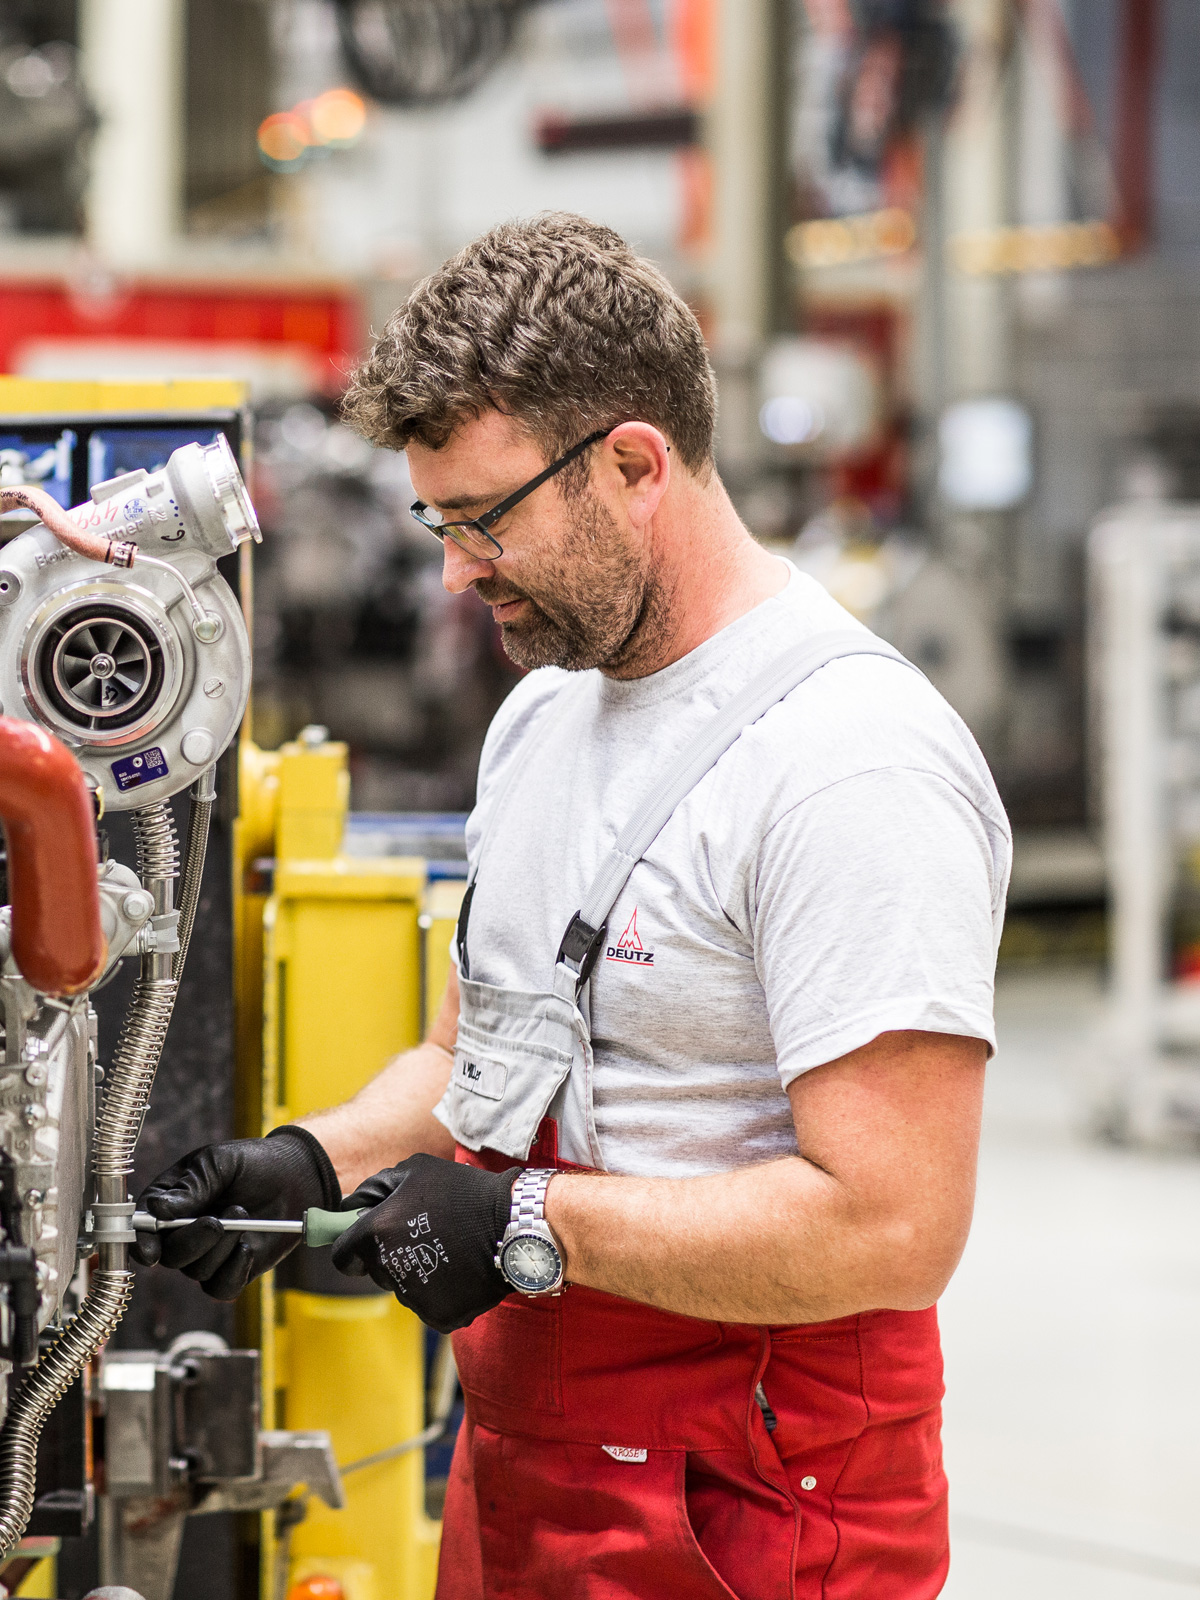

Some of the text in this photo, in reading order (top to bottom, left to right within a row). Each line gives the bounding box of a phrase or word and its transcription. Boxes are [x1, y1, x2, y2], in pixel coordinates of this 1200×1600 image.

[606, 946, 654, 963] DEUTZ
[433, 1238, 449, 1263] 4131
[404, 1245, 429, 1284] EN 388
